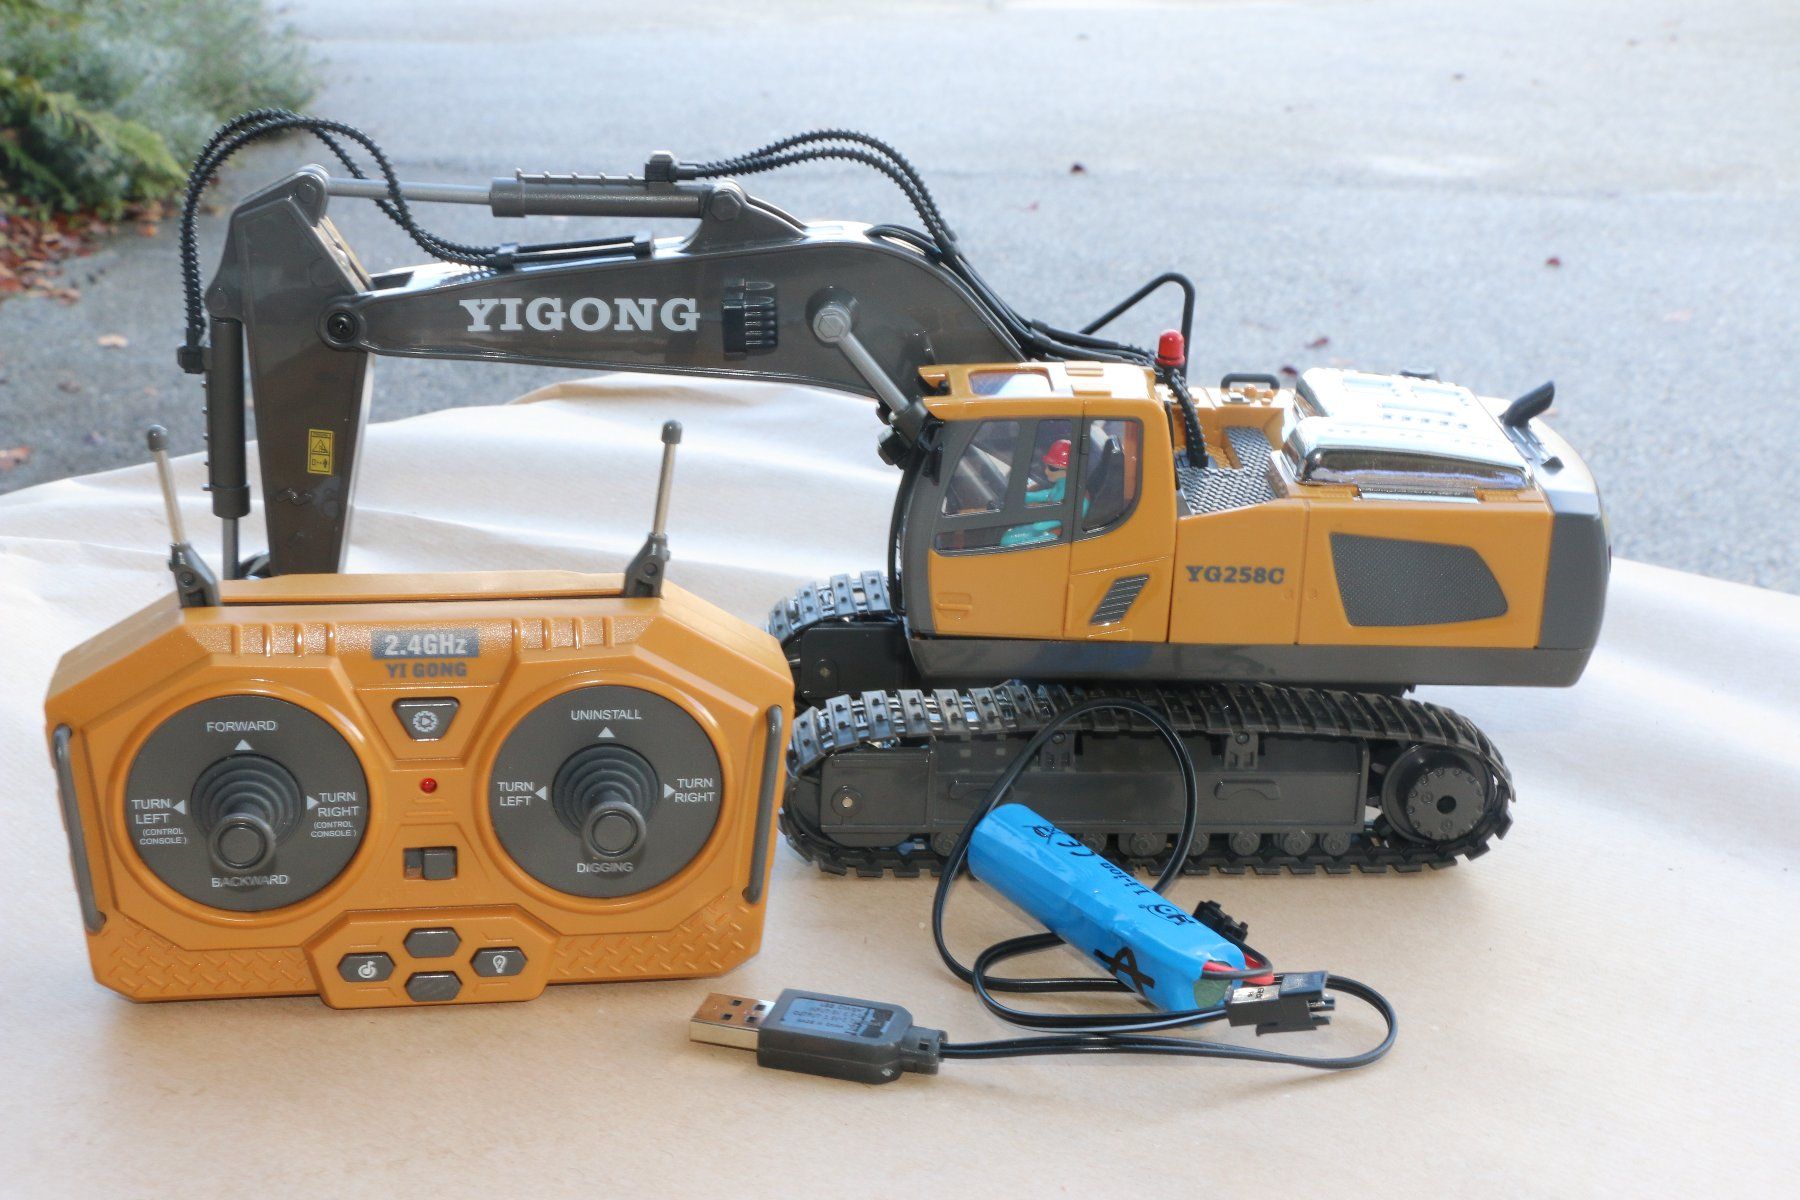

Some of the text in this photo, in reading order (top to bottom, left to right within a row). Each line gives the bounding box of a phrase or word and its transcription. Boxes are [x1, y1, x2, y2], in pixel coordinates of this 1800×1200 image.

[459, 297, 700, 331] YIGONG
[1186, 565, 1285, 585] YG258C
[384, 633, 468, 656] 2.4GHz
[385, 661, 468, 678] YI GONG
[570, 709, 642, 721] UNINSTALL
[206, 720, 277, 732] FORWARD
[497, 781, 534, 792] TURN
[677, 777, 713, 788] TURN
[319, 791, 356, 802] TURN
[499, 796, 532, 806] LEFT
[675, 792, 715, 803] RIGHT
[131, 798, 171, 810] TURN
[317, 805, 360, 817] RIGHT
[135, 813, 170, 824] LEFT
[313, 820, 354, 829] (CONTROL
[142, 828, 184, 836] (CONTROL
[576, 862, 634, 873] DIGGING
[211, 874, 289, 888] BACKWARD
